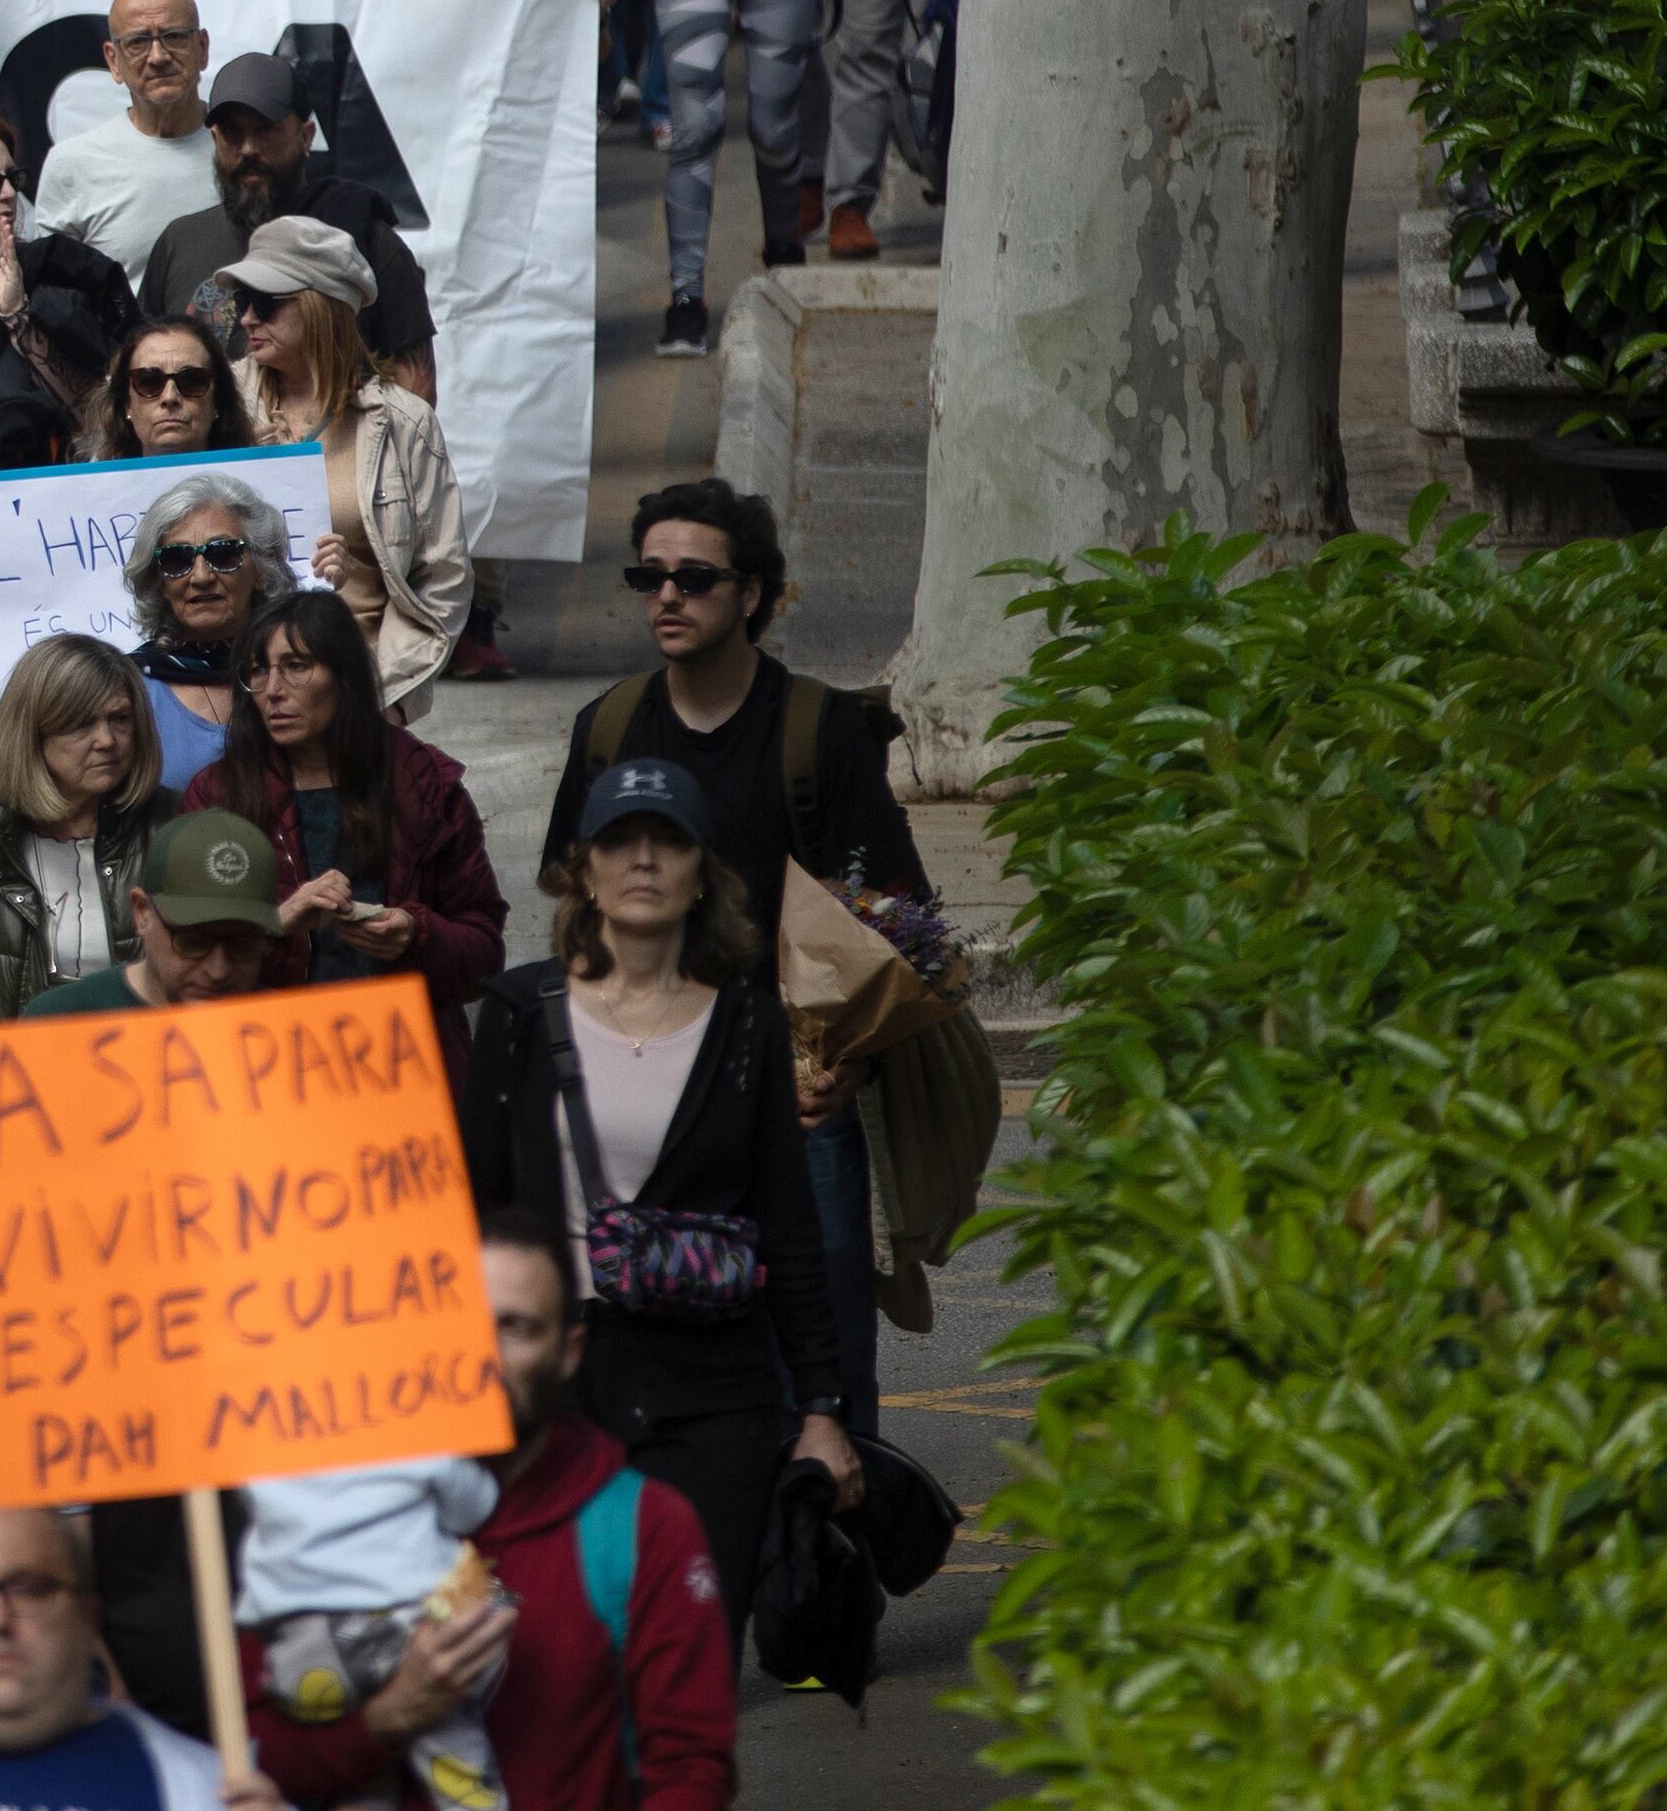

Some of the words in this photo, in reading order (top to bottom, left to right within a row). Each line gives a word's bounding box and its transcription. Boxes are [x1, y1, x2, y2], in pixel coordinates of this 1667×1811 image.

[234, 1004, 438, 1114] PARA
[357, 1131, 457, 1220] PARA
[29, 1410, 161, 1491] PAH
[204, 1350, 507, 1453] MALLORCA
